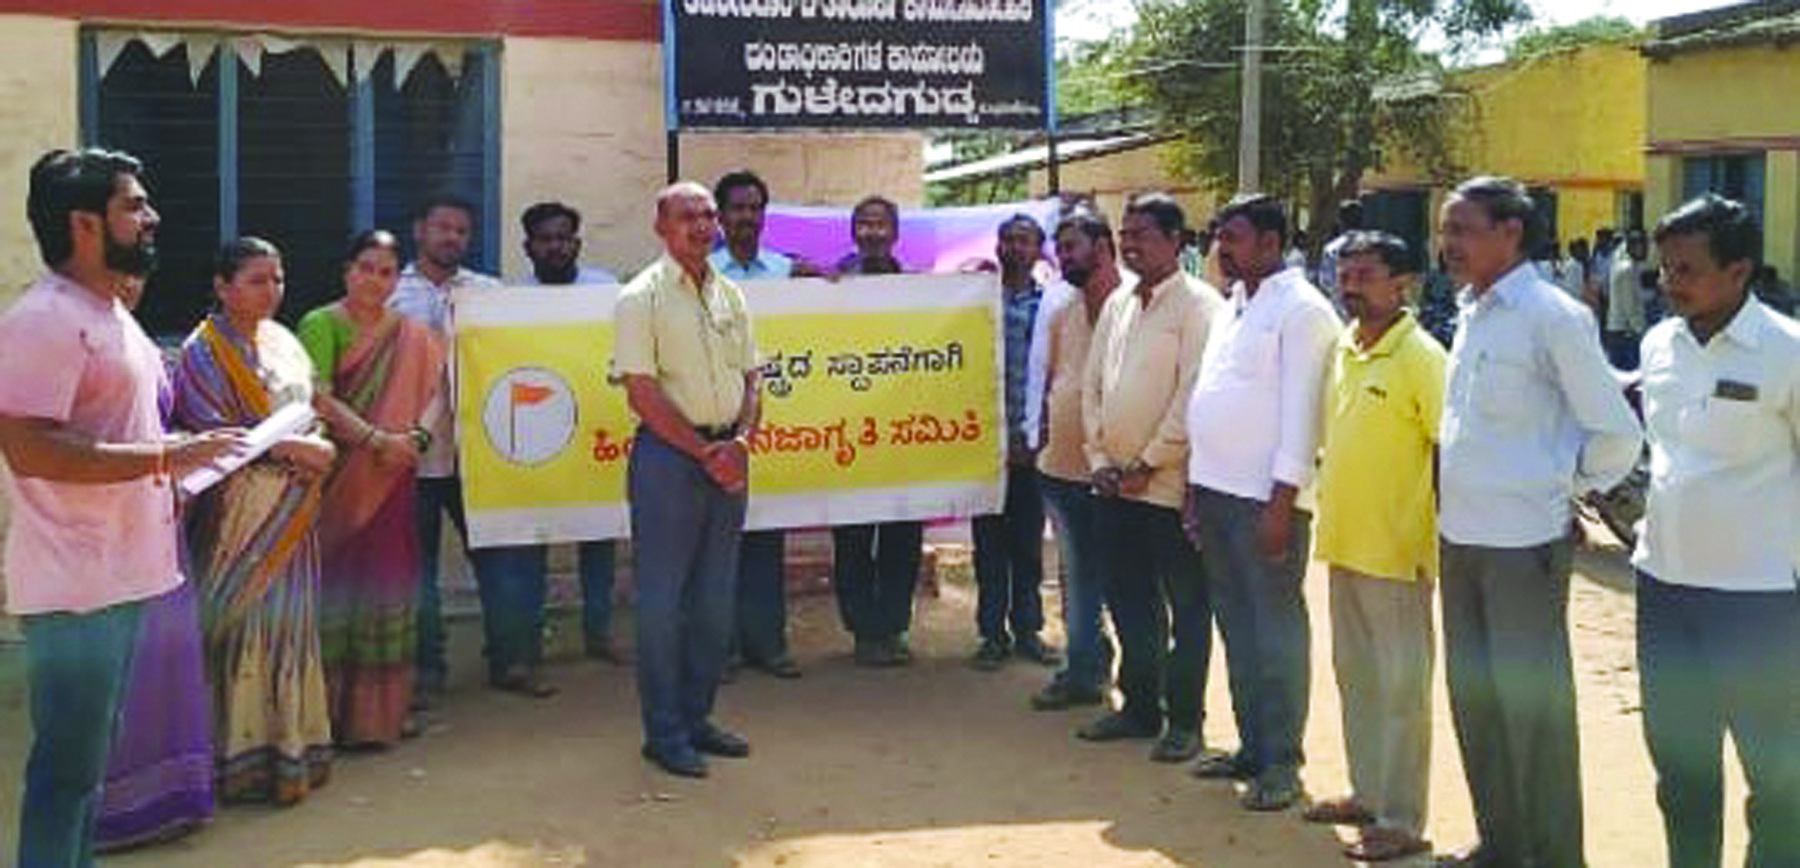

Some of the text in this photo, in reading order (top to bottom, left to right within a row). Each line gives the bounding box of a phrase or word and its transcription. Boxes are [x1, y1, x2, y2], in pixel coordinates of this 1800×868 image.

[752, 77, 980, 124] ಗುಳೇದಗುಡ್ಡ
[758, 350, 813, 396] ಷ್ಟ್ರದ
[747, 416, 878, 467] ನಜಾಗೃತಿ
[890, 409, 982, 446] ಸಮಿತಿ
